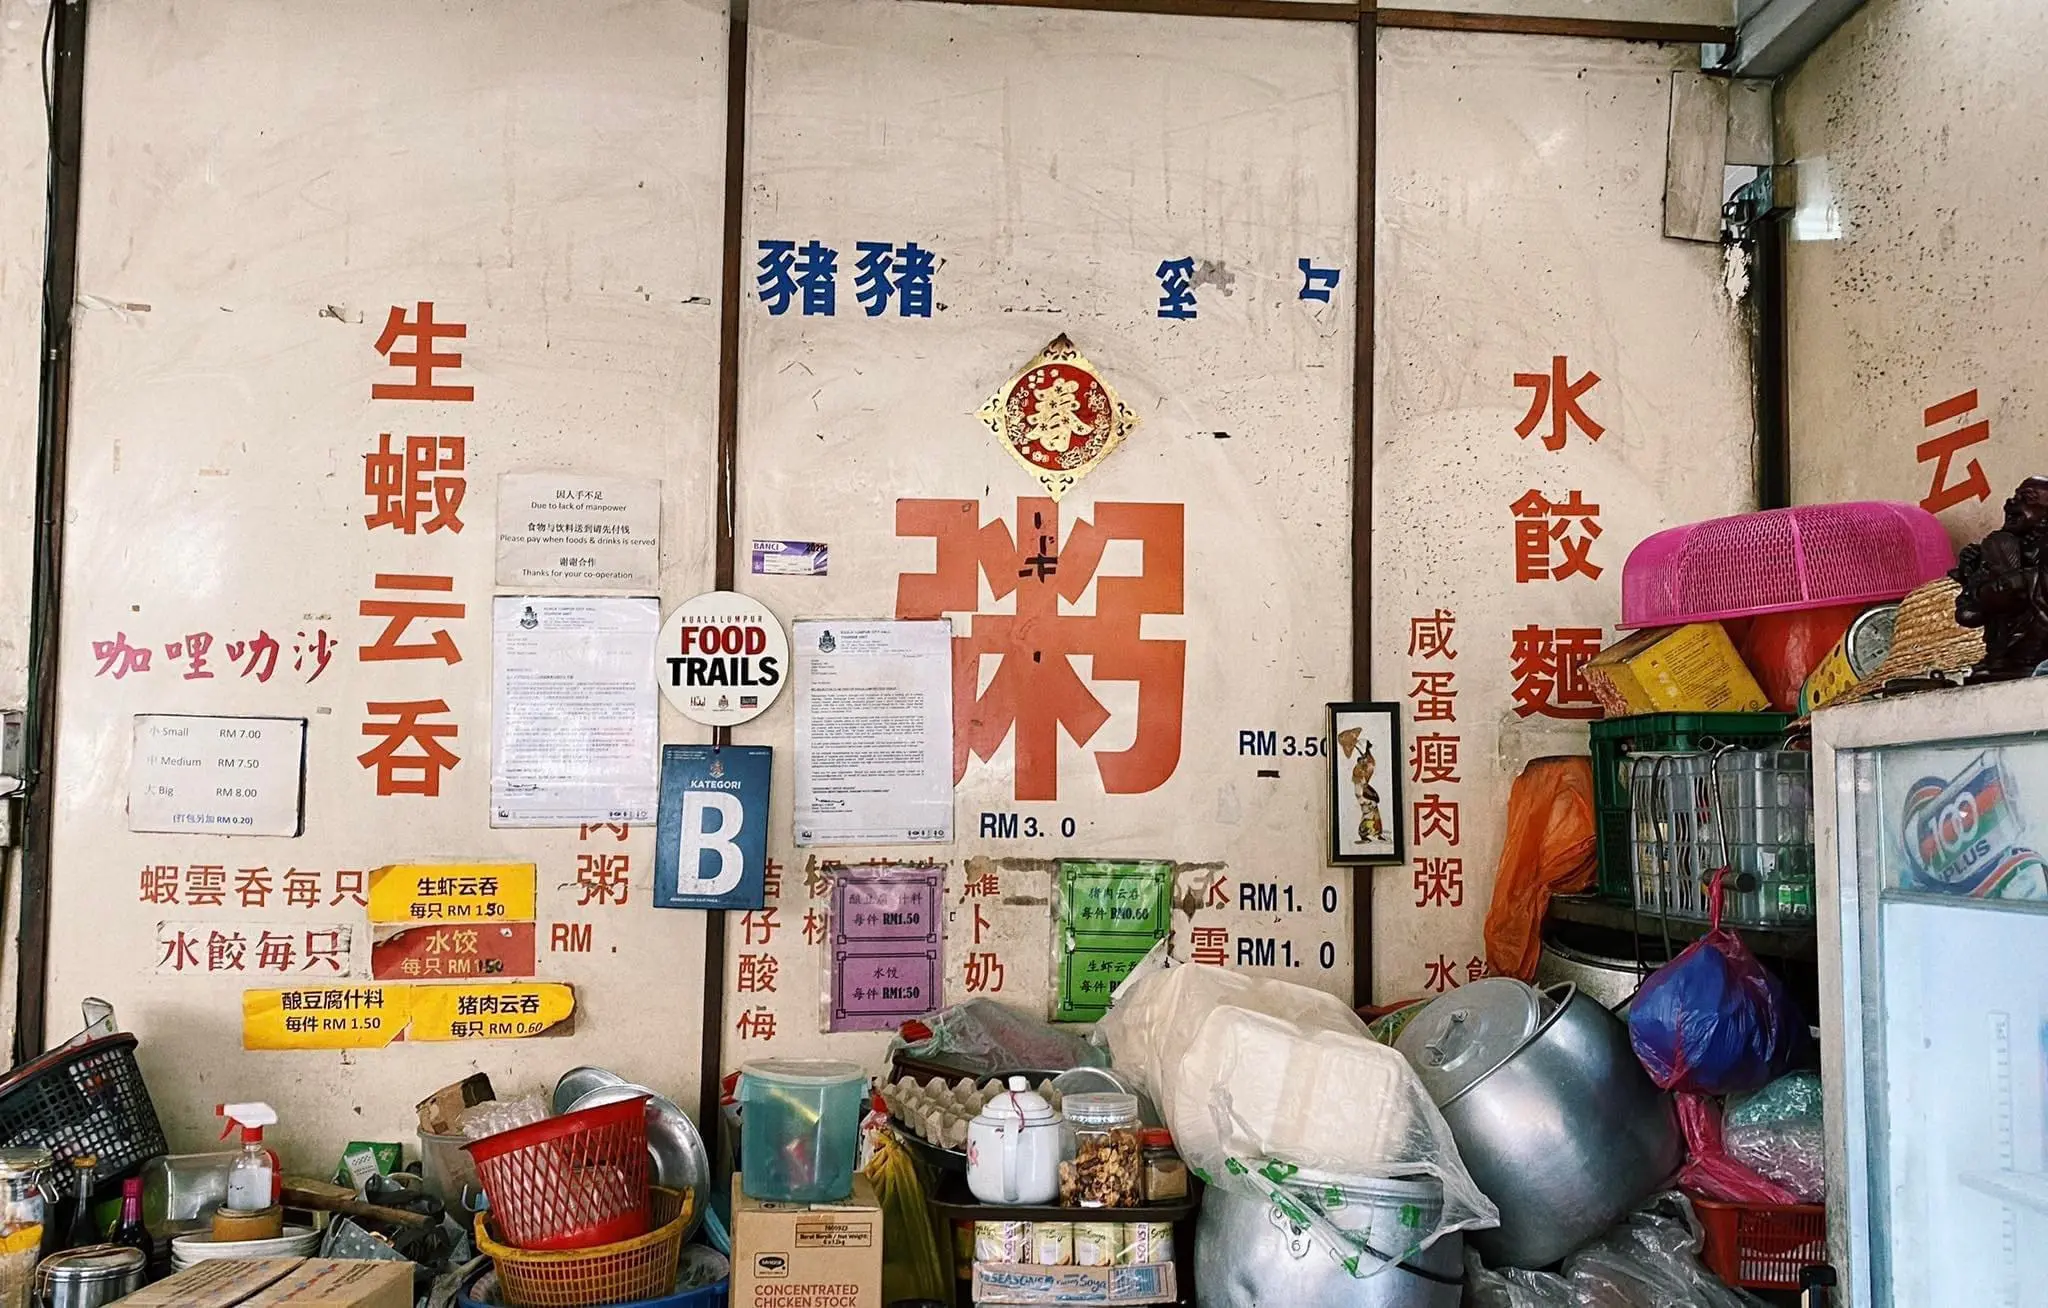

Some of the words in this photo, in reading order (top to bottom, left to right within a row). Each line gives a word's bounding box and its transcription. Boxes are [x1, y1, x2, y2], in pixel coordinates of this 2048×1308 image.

[1916, 388, 1991, 513] 云
[556, 489, 603, 500] 因人手不足
[558, 502, 573, 510] lack
[575, 502, 584, 510] of
[585, 504, 627, 512] manpower
[528, 522, 630, 534] 食物与饮料送到请先付钱
[500, 534, 524, 542] Please
[526, 536, 540, 544] pay
[544, 535, 563, 543] when
[566, 536, 587, 544] foods
[598, 536, 620, 545] drinks
[622, 537, 629, 545] is
[631, 538, 656, 546] served
[753, 542, 779, 550] BANCI
[559, 557, 596, 567] 谢谢合作
[522, 568, 549, 577] Thanks
[551, 568, 562, 577] for
[564, 570, 581, 579] your
[584, 571, 633, 579] co-operation
[720, 615, 762, 623] LUMPUR
[681, 626, 766, 655] FOOD
[895, 496, 1187, 800] 粥
[92, 630, 339, 684] 咖哩叻沙
[666, 656, 780, 686] TRAILS
[162, 728, 189, 737] Small
[219, 729, 236, 738] RM
[240, 730, 261, 739] 7.00
[1239, 730, 1277, 756] RM
[160, 757, 202, 766] Medium
[217, 758, 235, 768] RM
[238, 759, 259, 768] 7.50
[1407, 608, 1464, 907] 咸蛋瘦肉粥
[158, 786, 174, 796] Big
[216, 788, 232, 797] RM
[235, 788, 257, 797] 8.00
[690, 780, 741, 789] KATEGORI
[232, 817, 253, 825] 0.20)
[980, 812, 1018, 838] RM
[677, 791, 744, 895] B
[1941, 839, 1991, 882] PLUS
[417, 877, 498, 897] 生虾云吞
[1239, 883, 1278, 911] RM
[410, 902, 443, 919] 每只
[448, 905, 470, 916] RM
[883, 913, 920, 925] RM1.50
[425, 930, 479, 954] 水饺
[551, 923, 592, 953] RM
[157, 930, 342, 972] 水餃每只
[1190, 927, 1229, 967] 雪
[1237, 937, 1275, 966] RM
[401, 958, 442, 976] 每只
[448, 960, 471, 973] RM
[873, 966, 899, 979] 水饺
[281, 988, 384, 1010] 酿豆腐什料
[458, 995, 540, 1015] 猪肉云吞
[285, 1016, 318, 1033] 每件
[323, 1018, 346, 1030] RM
[351, 1017, 381, 1030] 1.50
[451, 1021, 483, 1037] 每只
[489, 1023, 513, 1034] RM
[516, 1022, 543, 1034] 0.60
[755, 1284, 858, 1296] CONCENTRATED
[754, 1296, 811, 1308] CHICKEN
[815, 1296, 857, 1308] STOCK
